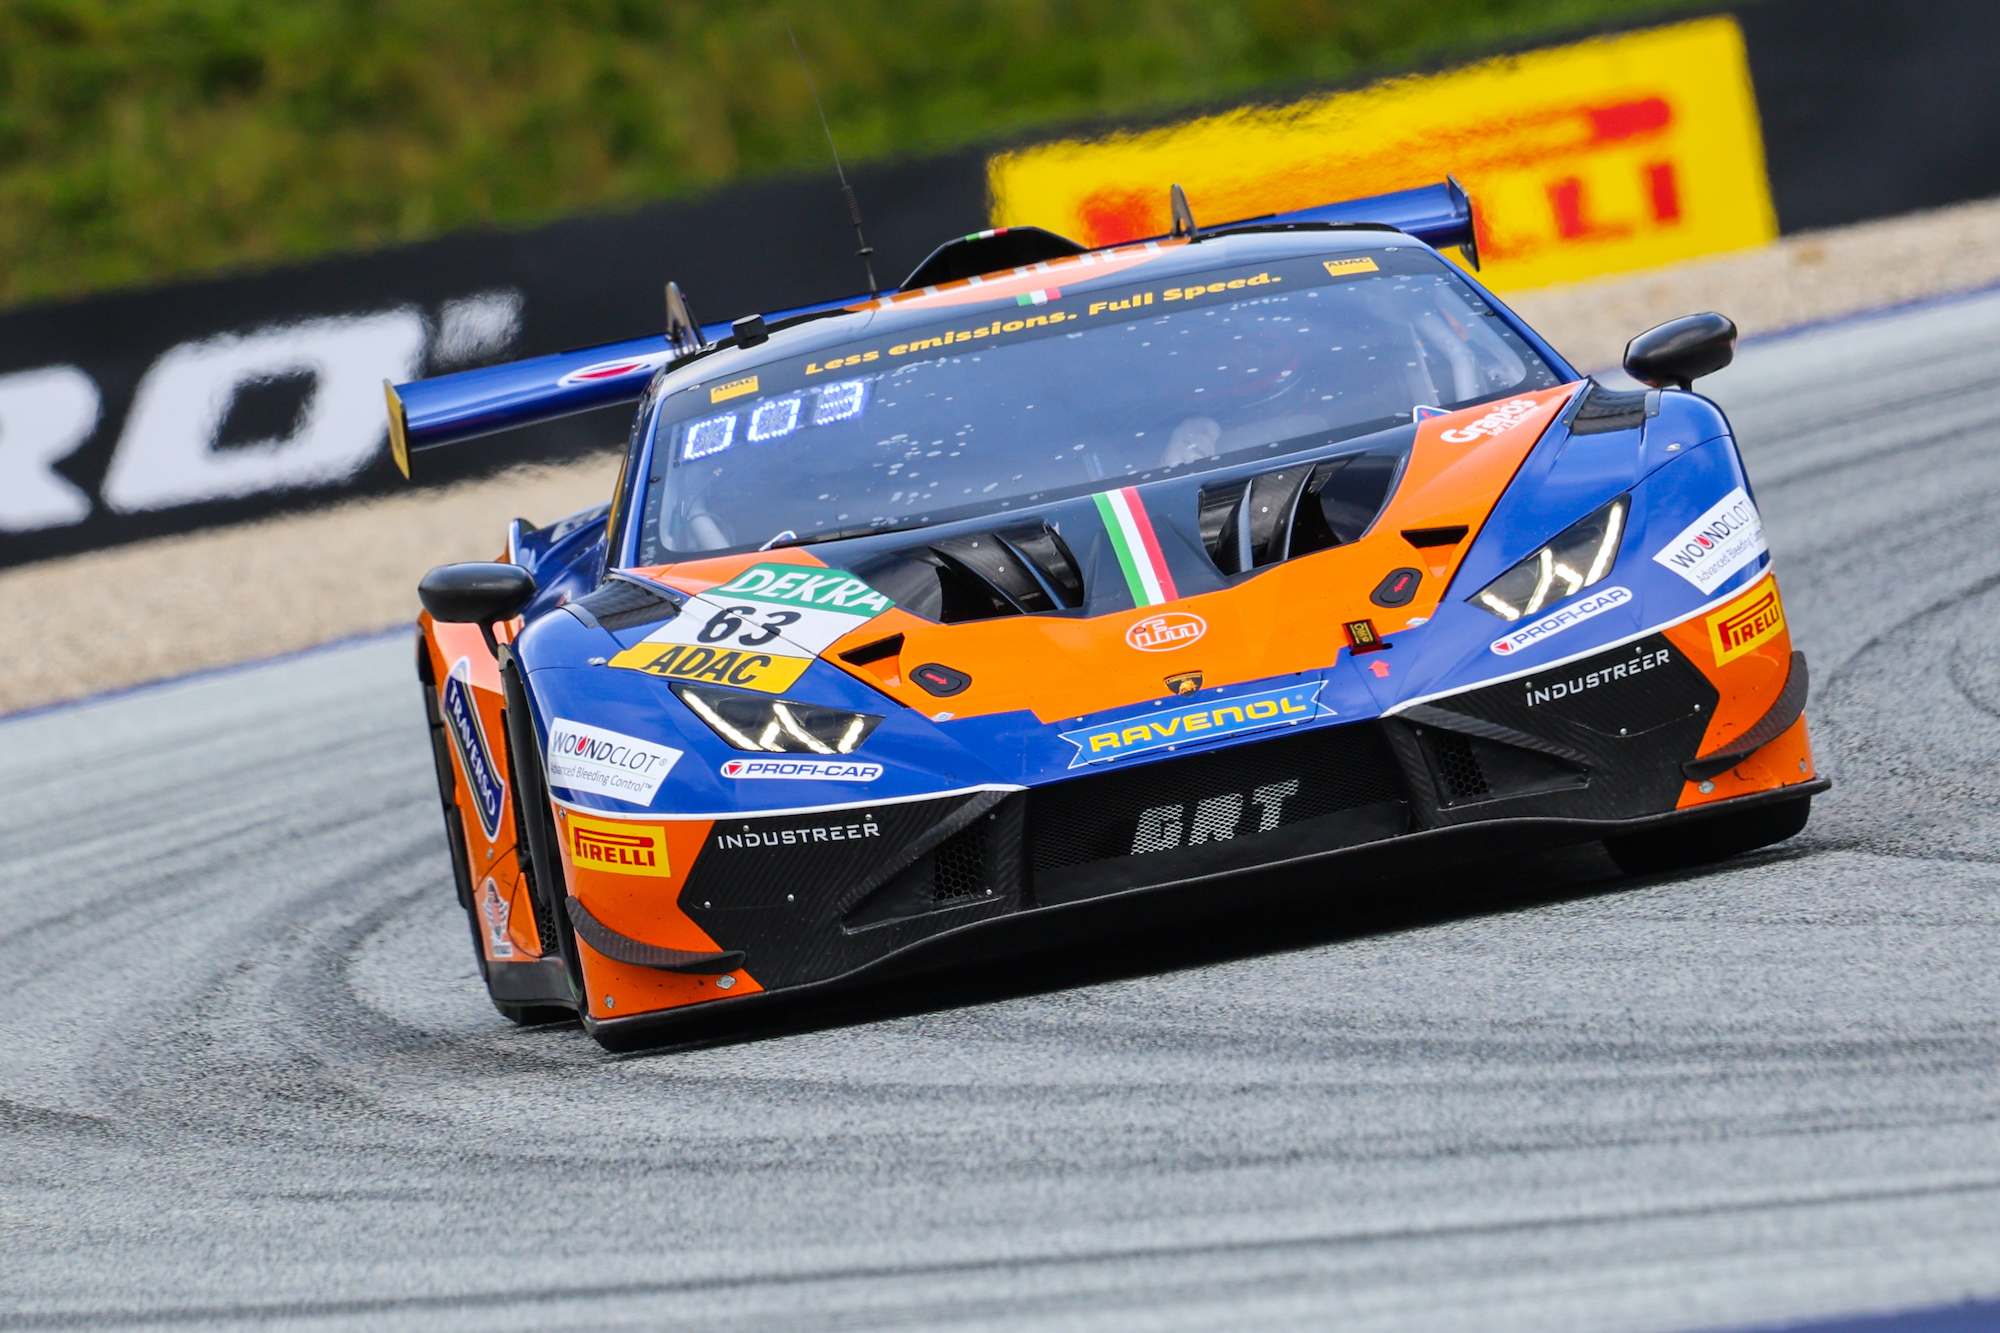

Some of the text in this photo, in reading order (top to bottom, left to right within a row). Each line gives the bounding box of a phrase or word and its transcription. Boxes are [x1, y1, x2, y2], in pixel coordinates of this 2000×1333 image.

[805, 272, 1282, 375] Less emissions. Full Speed.
[718, 568, 889, 612] DEKRA
[696, 606, 802, 647] 63
[1512, 587, 1628, 647] PROFI-CAR
[1717, 590, 1780, 653] PIRELLI
[639, 645, 772, 685] ADAC
[1525, 647, 1671, 708] INDUSTREER
[449, 679, 496, 816] TRAVERSO
[1088, 697, 1307, 753] RAVENOL
[576, 766, 610, 787] Bleeding
[745, 762, 878, 779] PROFI-CAR
[717, 822, 881, 850] INDUSTREER
[1130, 778, 1300, 856] GRT
[573, 825, 656, 867] PIRELLI
